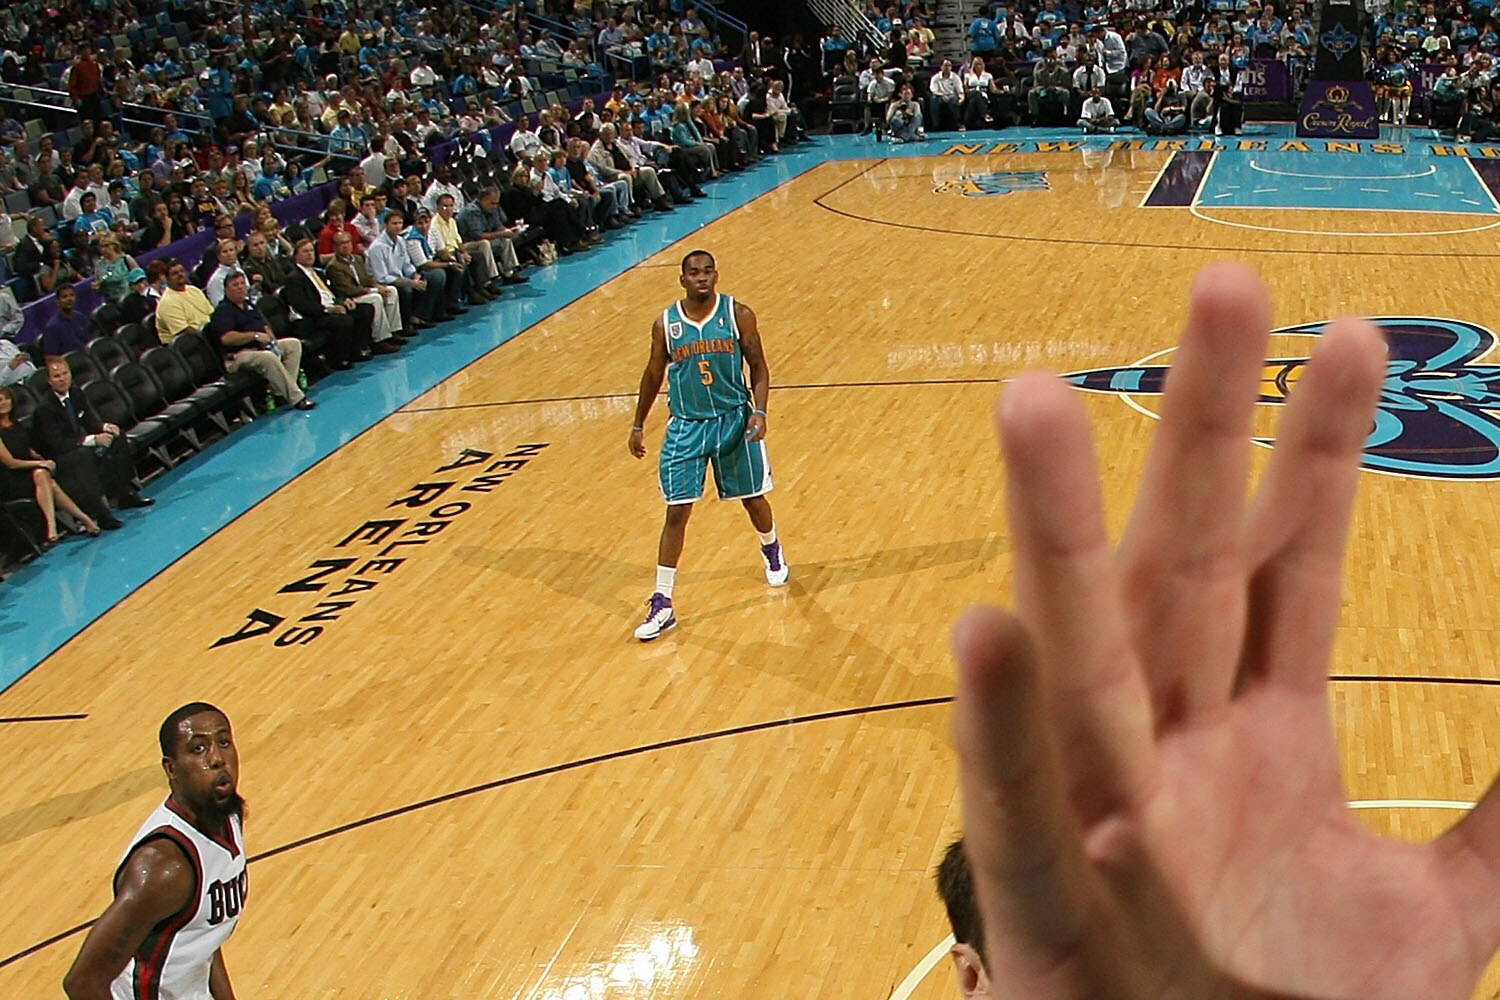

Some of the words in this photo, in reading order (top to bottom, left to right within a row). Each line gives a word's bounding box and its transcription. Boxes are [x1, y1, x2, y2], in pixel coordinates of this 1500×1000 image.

[1303, 112, 1337, 131] Crown
[1333, 113, 1375, 133] Royal
[939, 141, 1087, 156] NEW
[1105, 139, 1407, 154] ORLEANS
[672, 343, 692, 363] NEW
[693, 338, 736, 355] ORLEANS
[697, 360, 714, 387] 5
[460, 442, 551, 493] NEW
[207, 448, 495, 650] ARENA
[273, 501, 472, 648] ORLEANS
[206, 871, 248, 926] BU
